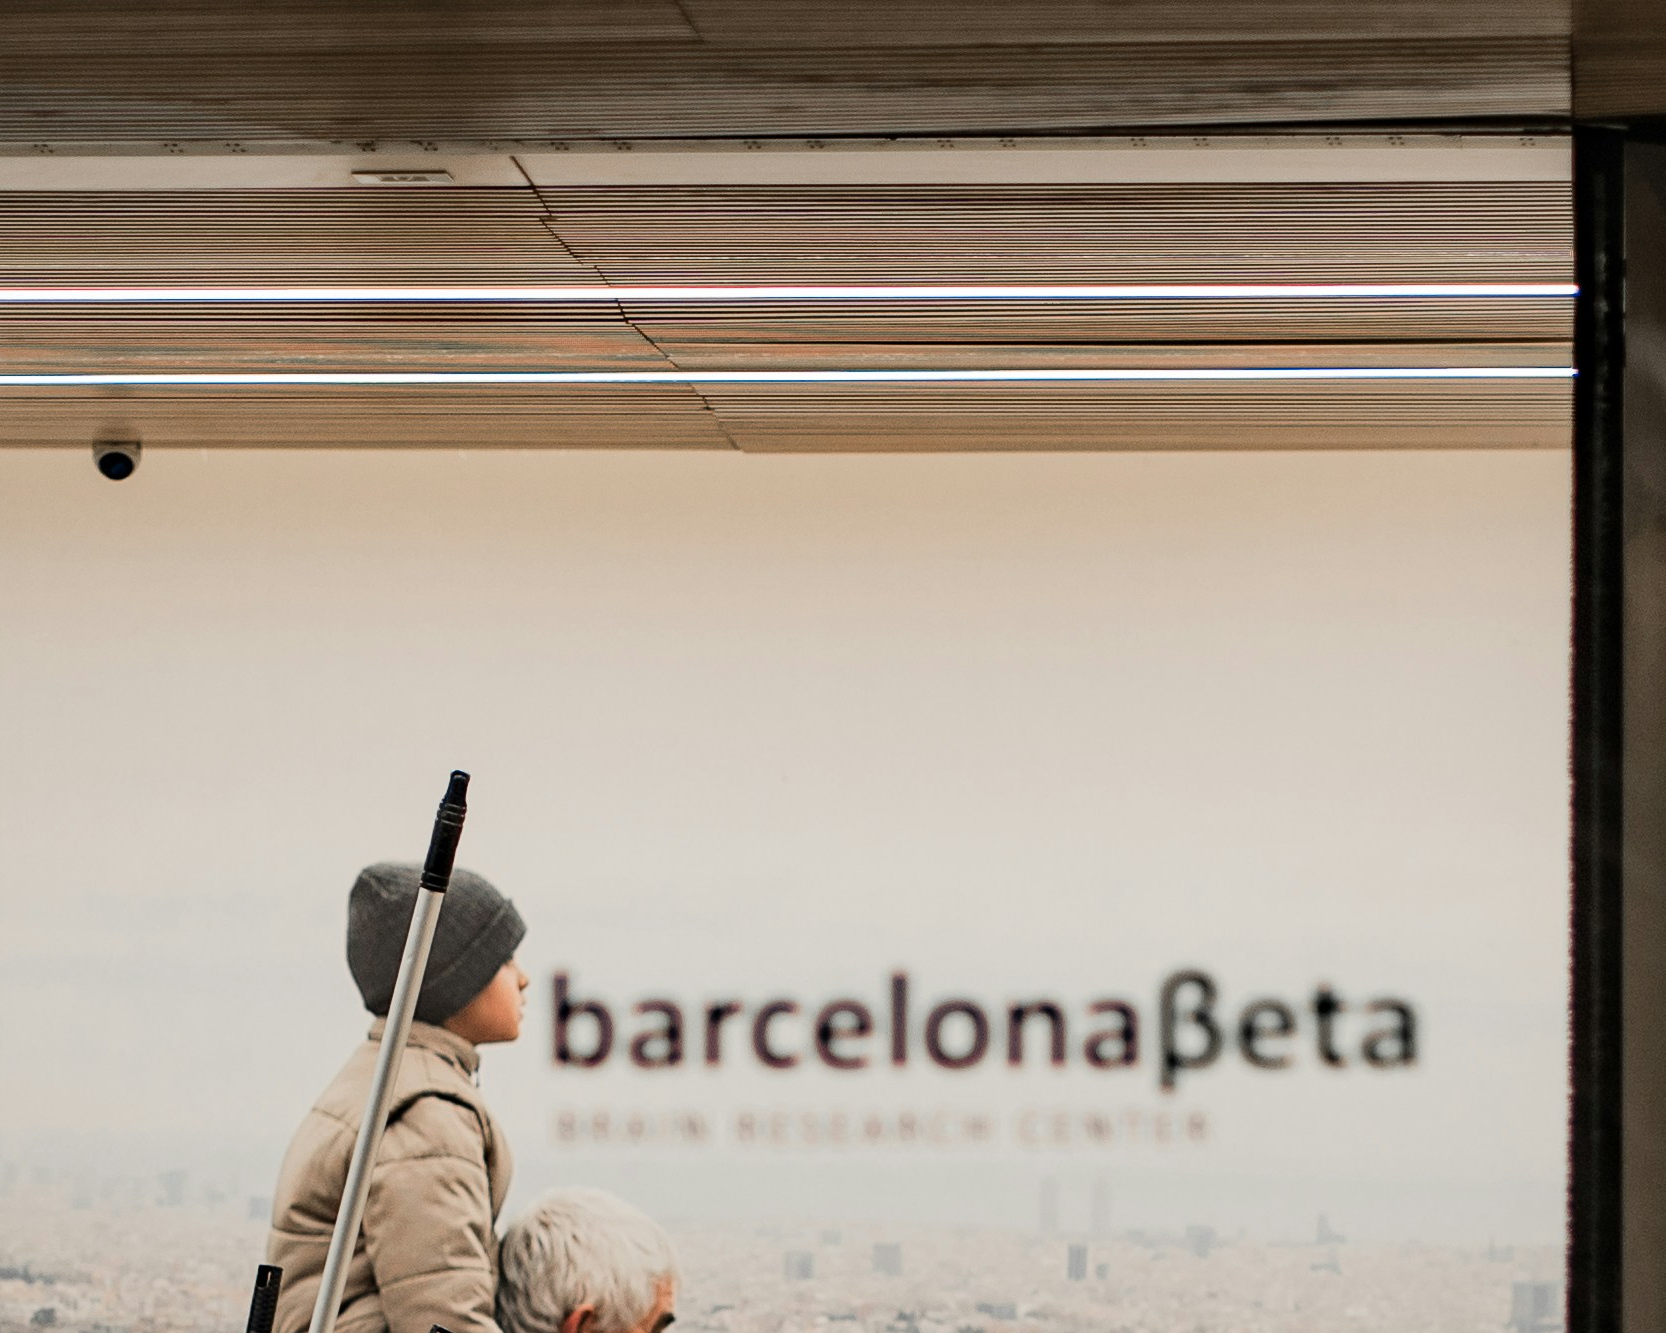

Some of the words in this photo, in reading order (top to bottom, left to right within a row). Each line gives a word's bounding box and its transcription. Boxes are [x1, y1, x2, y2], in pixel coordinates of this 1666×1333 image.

[555, 1106, 709, 1146] BRAIN
[735, 1106, 992, 1146] RESEARCH
[1017, 1106, 1212, 1146] CENTER
